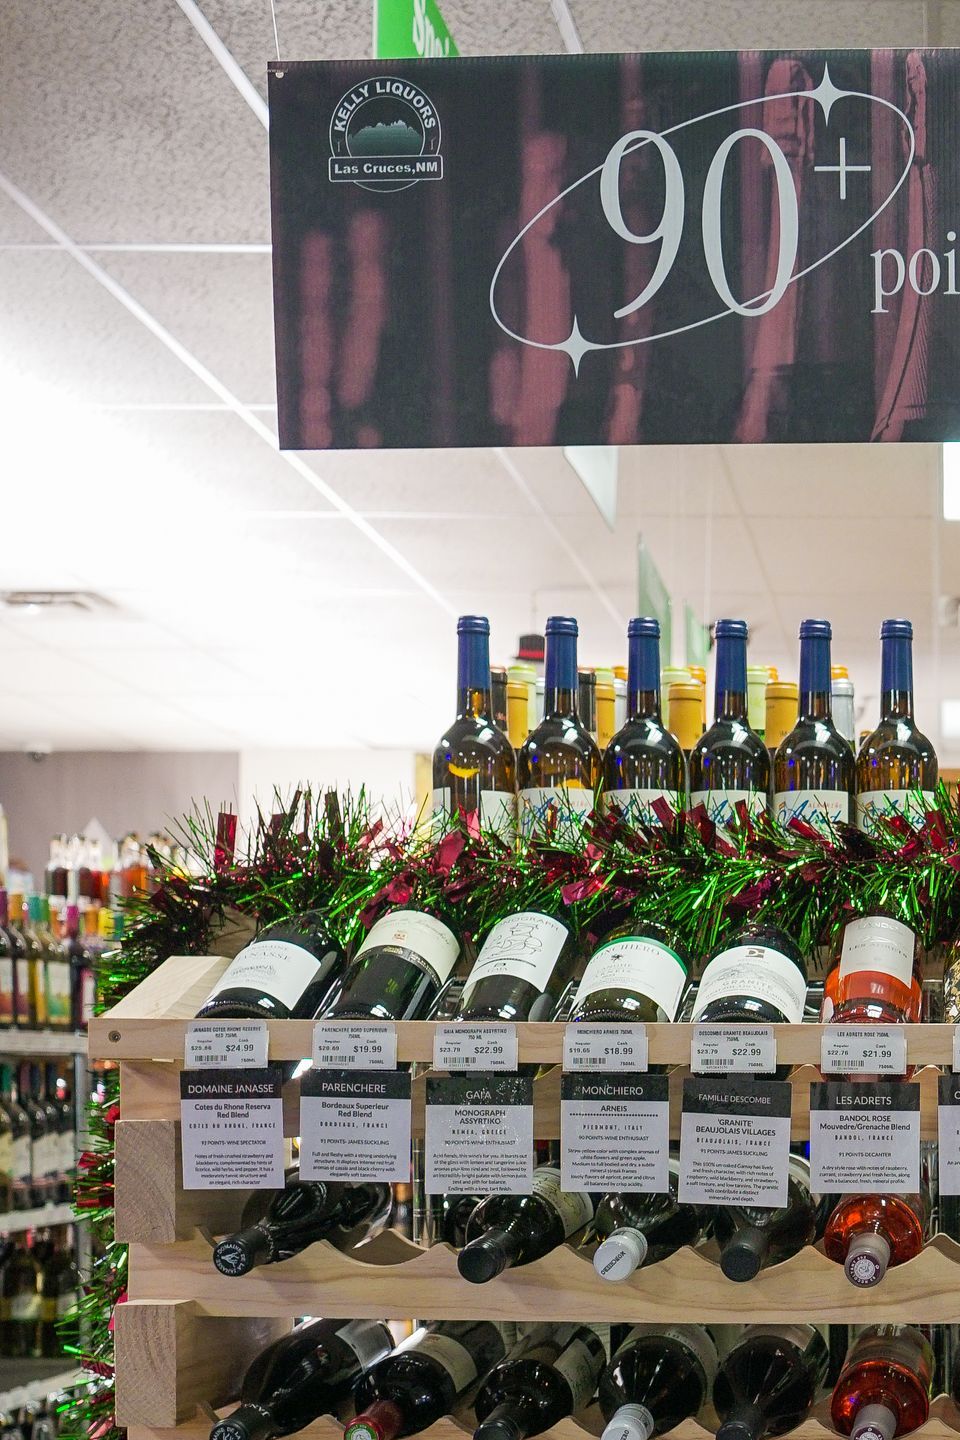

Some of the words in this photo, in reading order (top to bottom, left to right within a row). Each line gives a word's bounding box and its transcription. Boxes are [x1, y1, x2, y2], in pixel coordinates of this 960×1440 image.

[334, 84, 369, 132] KELLY
[376, 82, 436, 128] LIQUORS
[334, 164, 358, 174] Las
[363, 162, 438, 174] Cruces,NM
[188, 1084, 233, 1093] DOMAINE
[235, 1084, 274, 1093] JANASSE
[322, 1083, 386, 1093] PARENCHERE
[582, 1086, 644, 1095] MONCHIERO
[466, 1091, 492, 1099] GAIA
[698, 1094, 729, 1102] FAMILLE
[730, 1095, 772, 1104] DESCOMBE
[836, 1096, 852, 1104] LES
[854, 1096, 892, 1104] ADRETS
[321, 1102, 354, 1110] Bordeaux
[356, 1102, 389, 1111] Superieur
[696, 1126, 740, 1135] BEAUJOLAIS
[742, 1128, 776, 1136] VILLAGES
[820, 1123, 890, 1131] Mouvedre/Grenache
